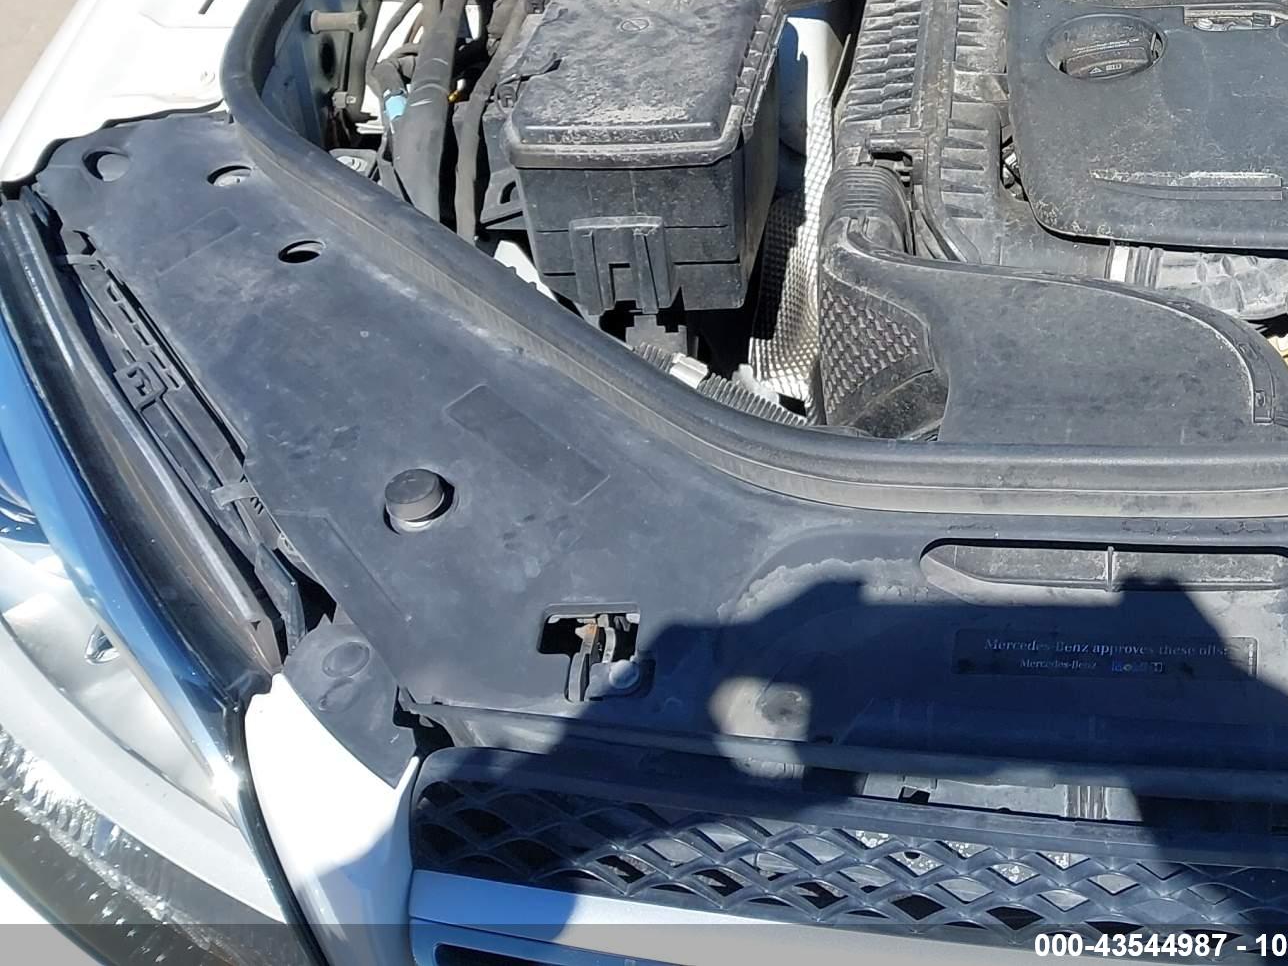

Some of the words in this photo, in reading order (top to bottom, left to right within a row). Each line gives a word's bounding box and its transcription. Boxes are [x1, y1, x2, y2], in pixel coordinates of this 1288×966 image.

[984, 638, 1088, 652] Mercedes-Benz
[1091, 642, 1153, 656] approves
[1159, 644, 1196, 656] these
